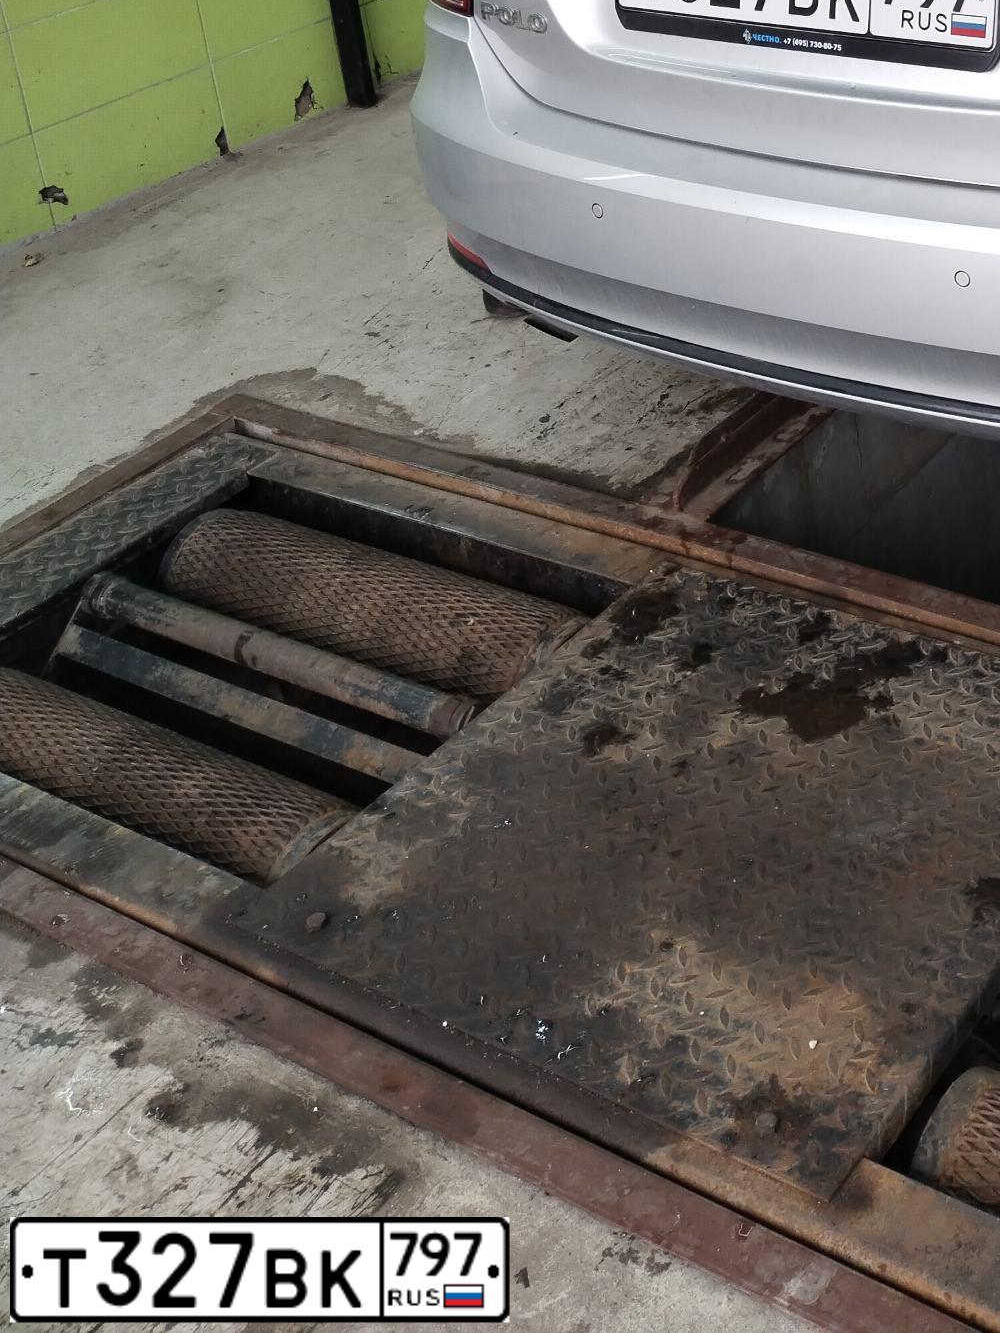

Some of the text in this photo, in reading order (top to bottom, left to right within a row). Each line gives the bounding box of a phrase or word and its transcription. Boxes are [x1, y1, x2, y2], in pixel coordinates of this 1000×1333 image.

[480, 1, 548, 34] POLO
[901, 10, 948, 32] RUS
[783, 37, 792, 45] +7
